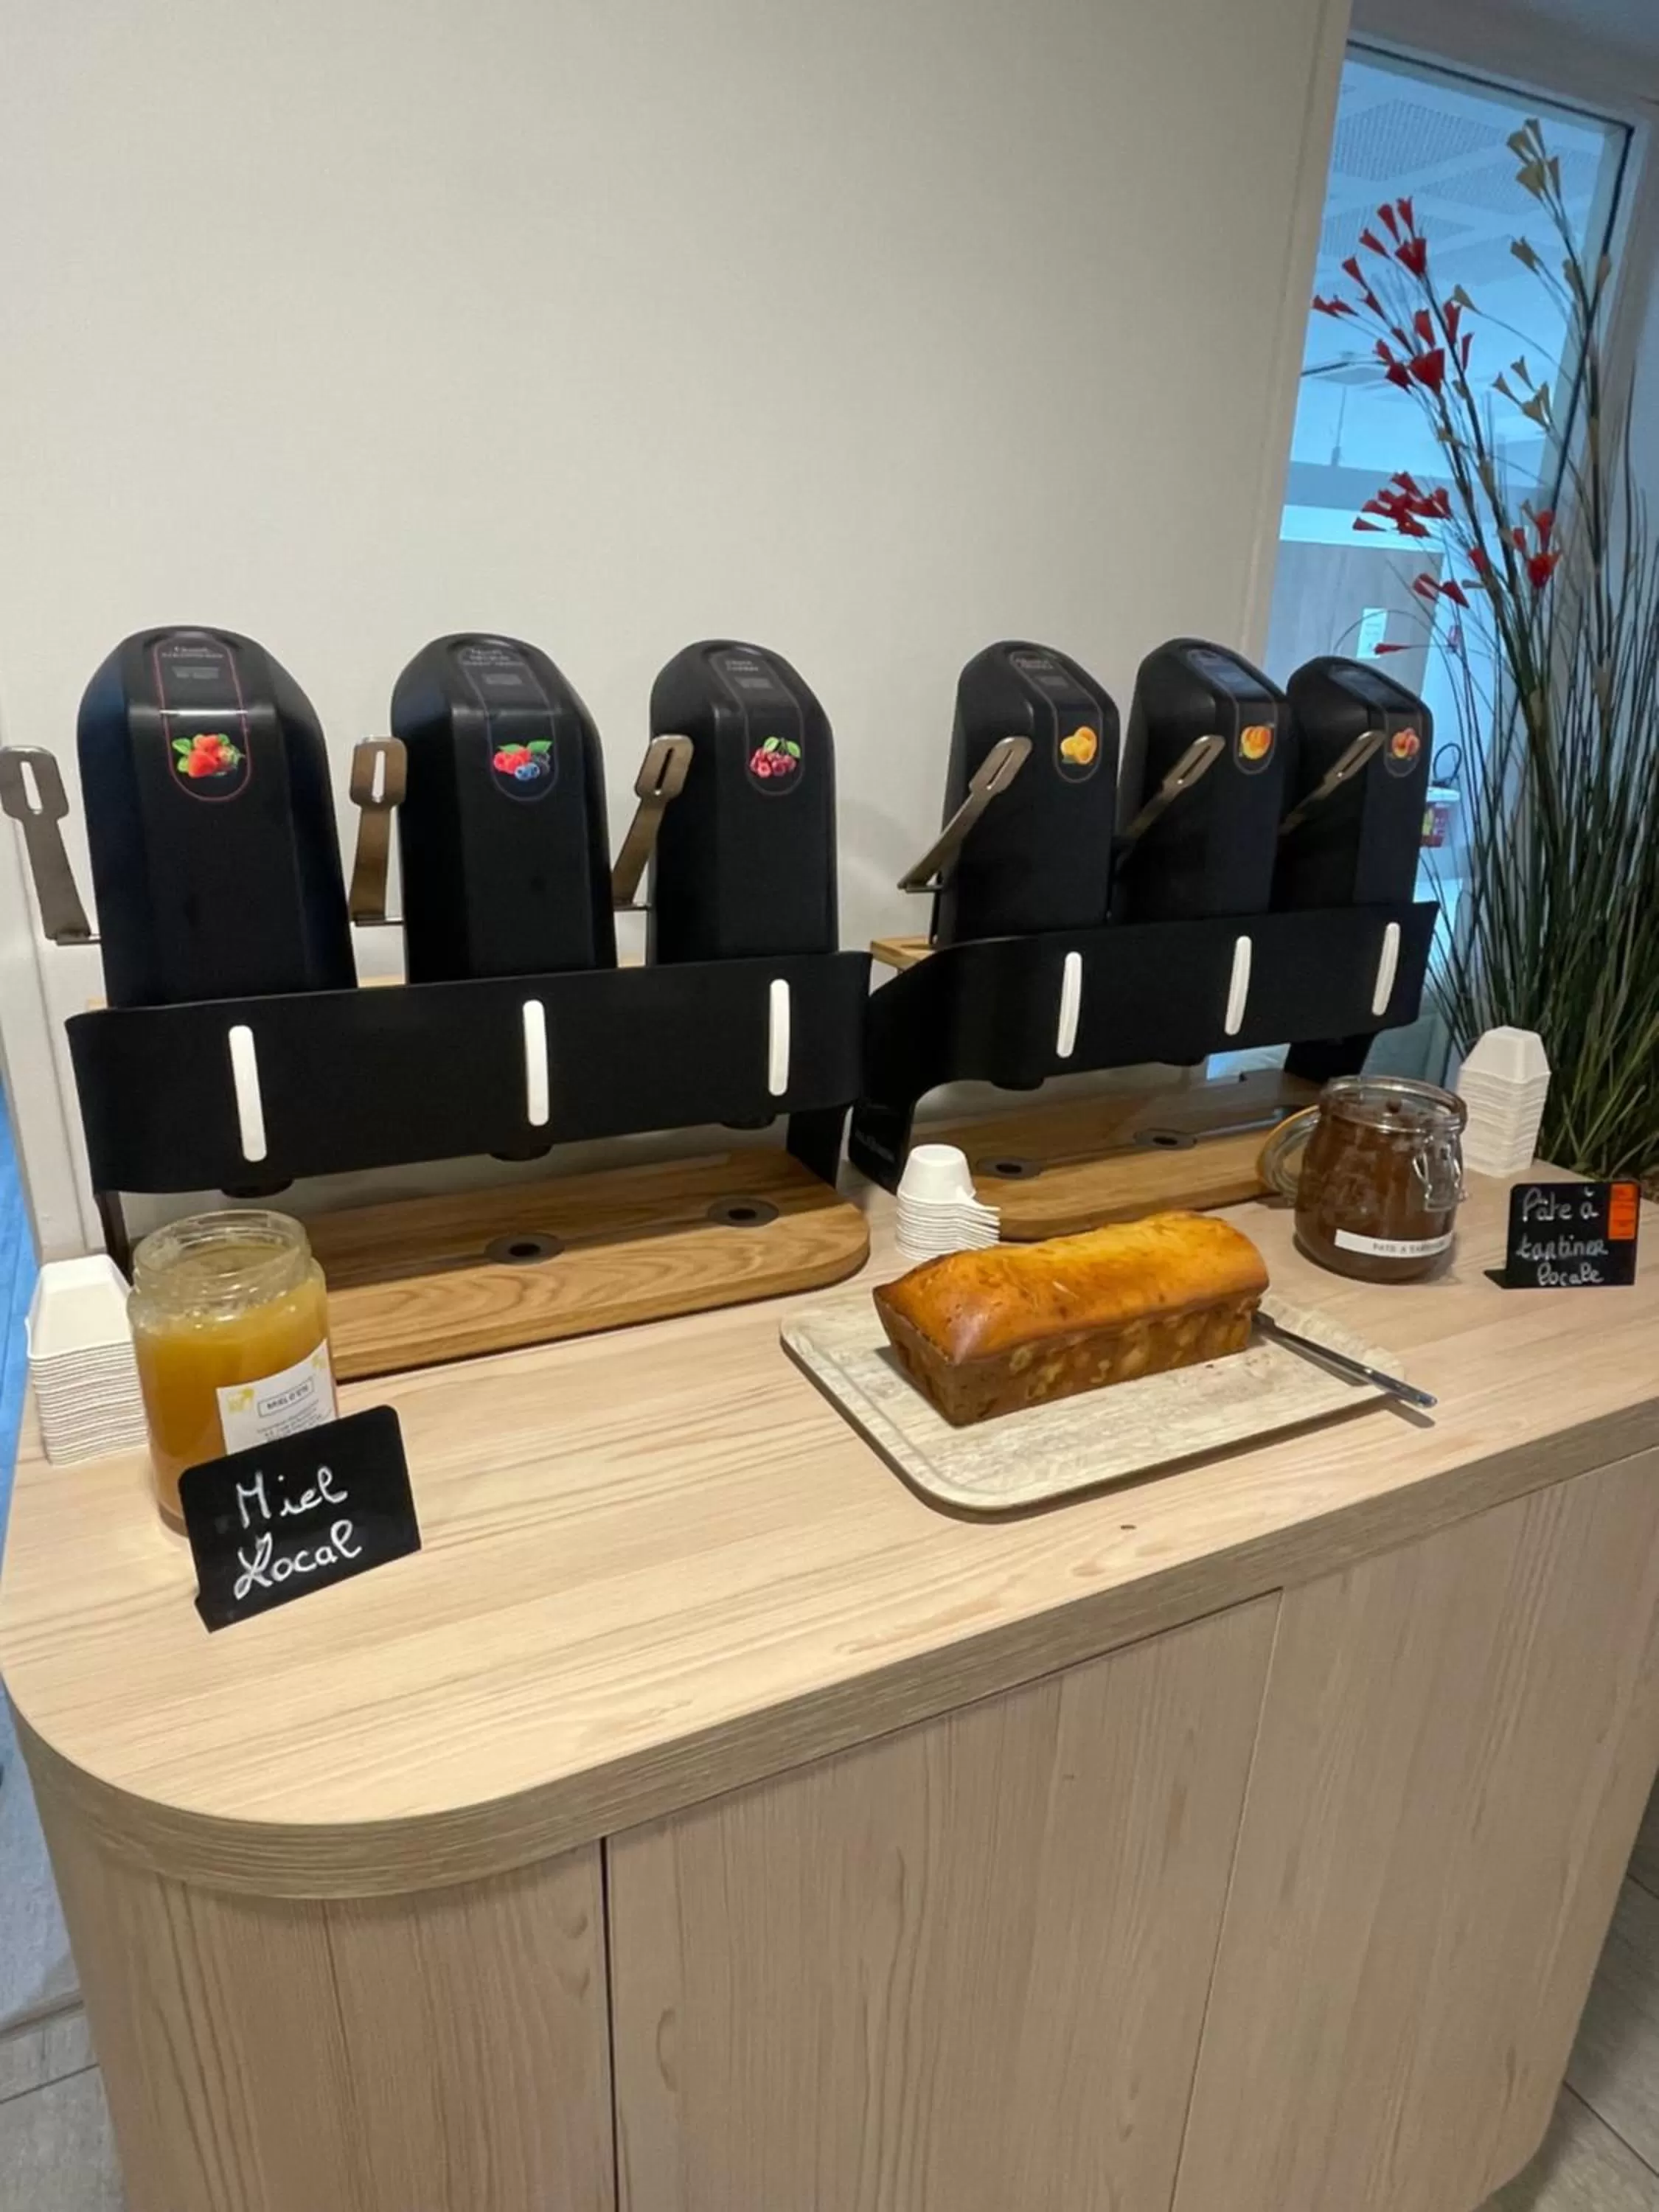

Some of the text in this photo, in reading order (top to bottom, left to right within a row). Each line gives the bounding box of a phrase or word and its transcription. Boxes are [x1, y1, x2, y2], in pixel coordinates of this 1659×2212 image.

[1580, 1186, 1599, 1219] à
[1537, 1262, 1604, 1286] locale
[235, 1465, 347, 1528] Miel
[234, 1520, 361, 1599] Local
